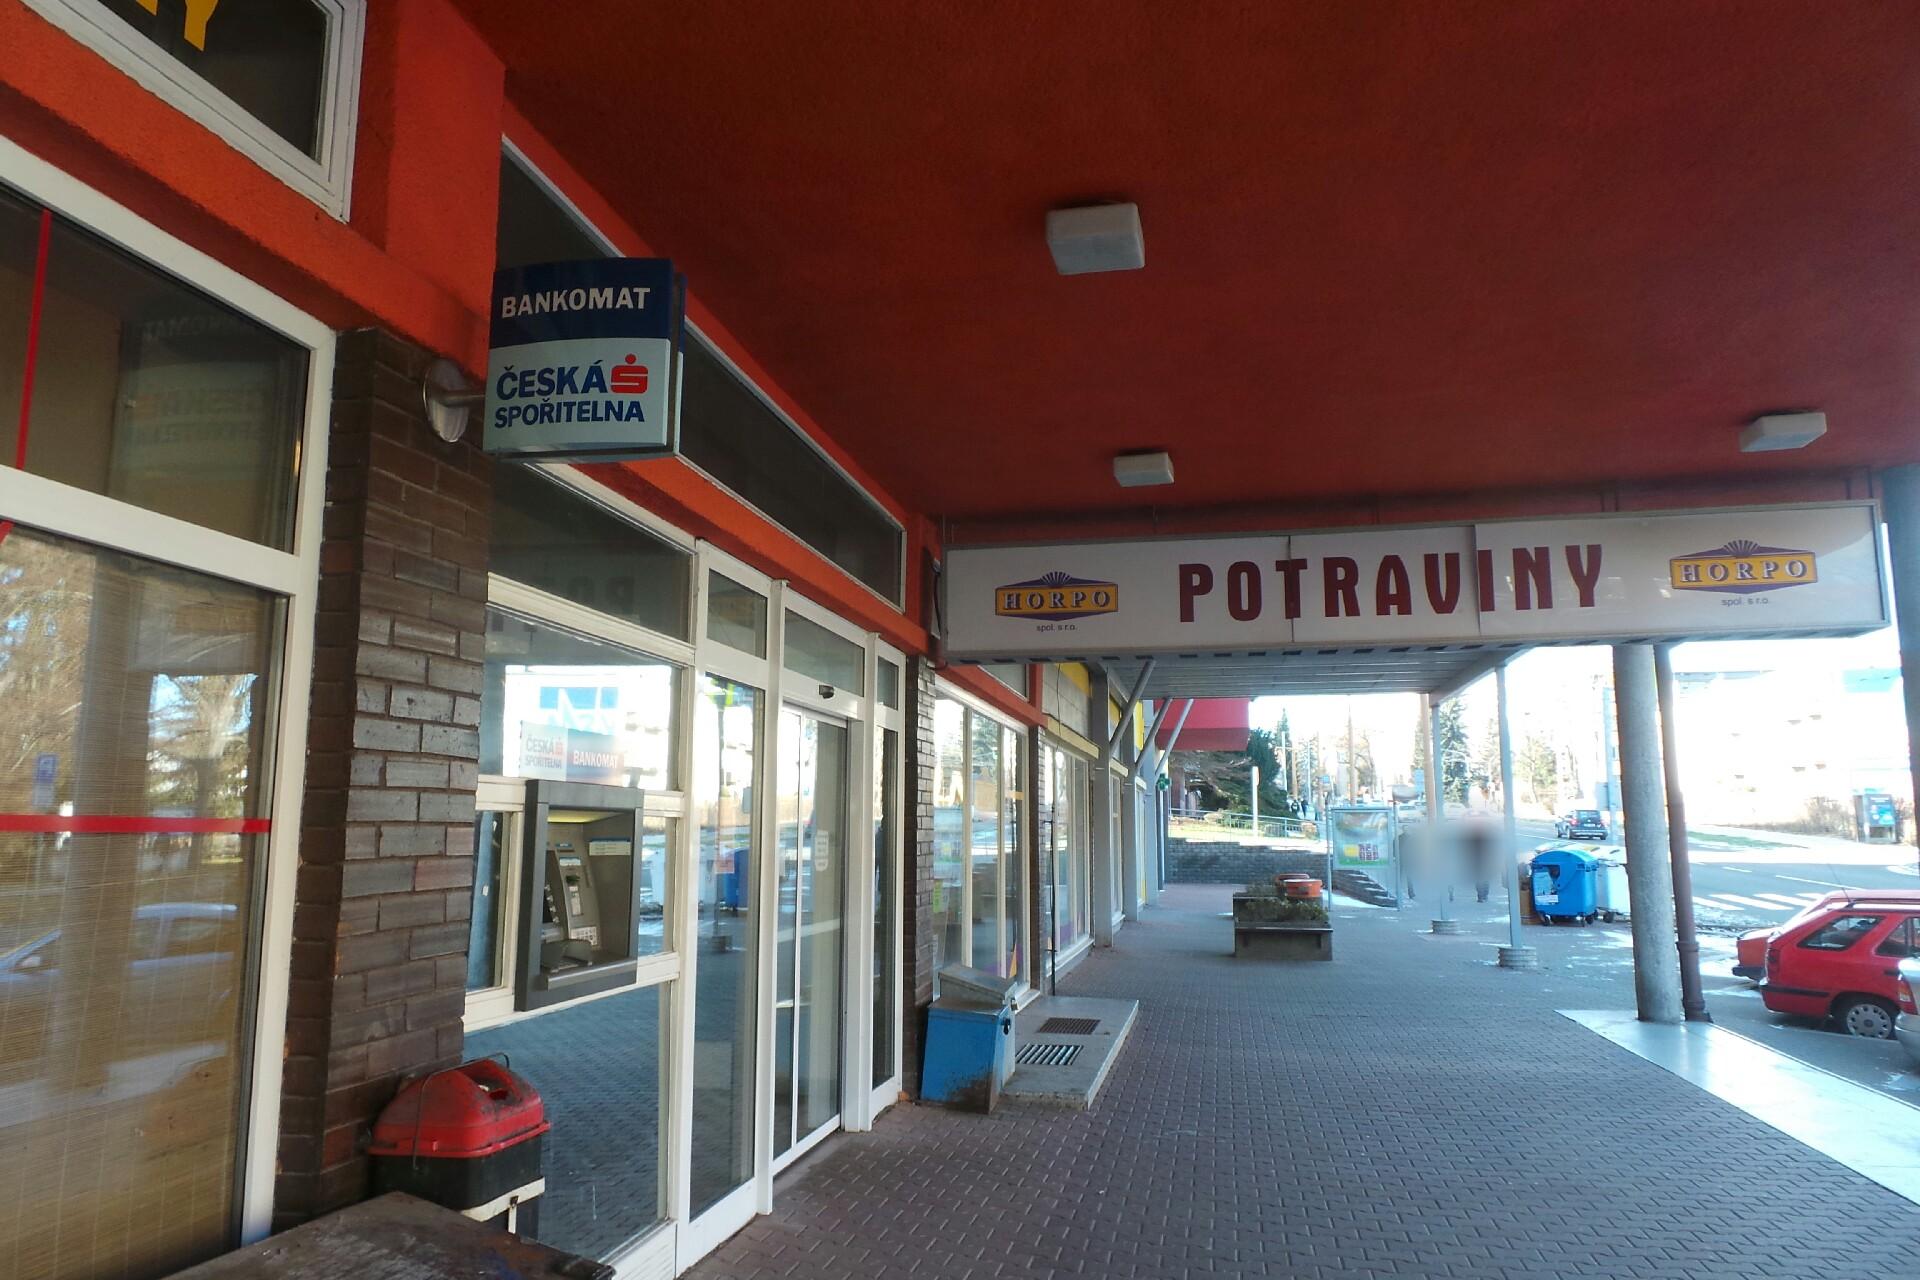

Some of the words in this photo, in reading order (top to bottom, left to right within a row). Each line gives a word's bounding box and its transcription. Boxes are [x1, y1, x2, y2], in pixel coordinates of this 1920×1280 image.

[501, 287, 651, 319] BANKOMAT
[496, 359, 609, 401] ČESKÁ
[494, 398, 645, 429] SPOŘITELNA
[1178, 543, 1603, 622] POTRAVINY
[1680, 559, 1808, 583] HORPO
[1003, 590, 1111, 611] HORPO
[573, 749, 618, 769] BANKOMAT
